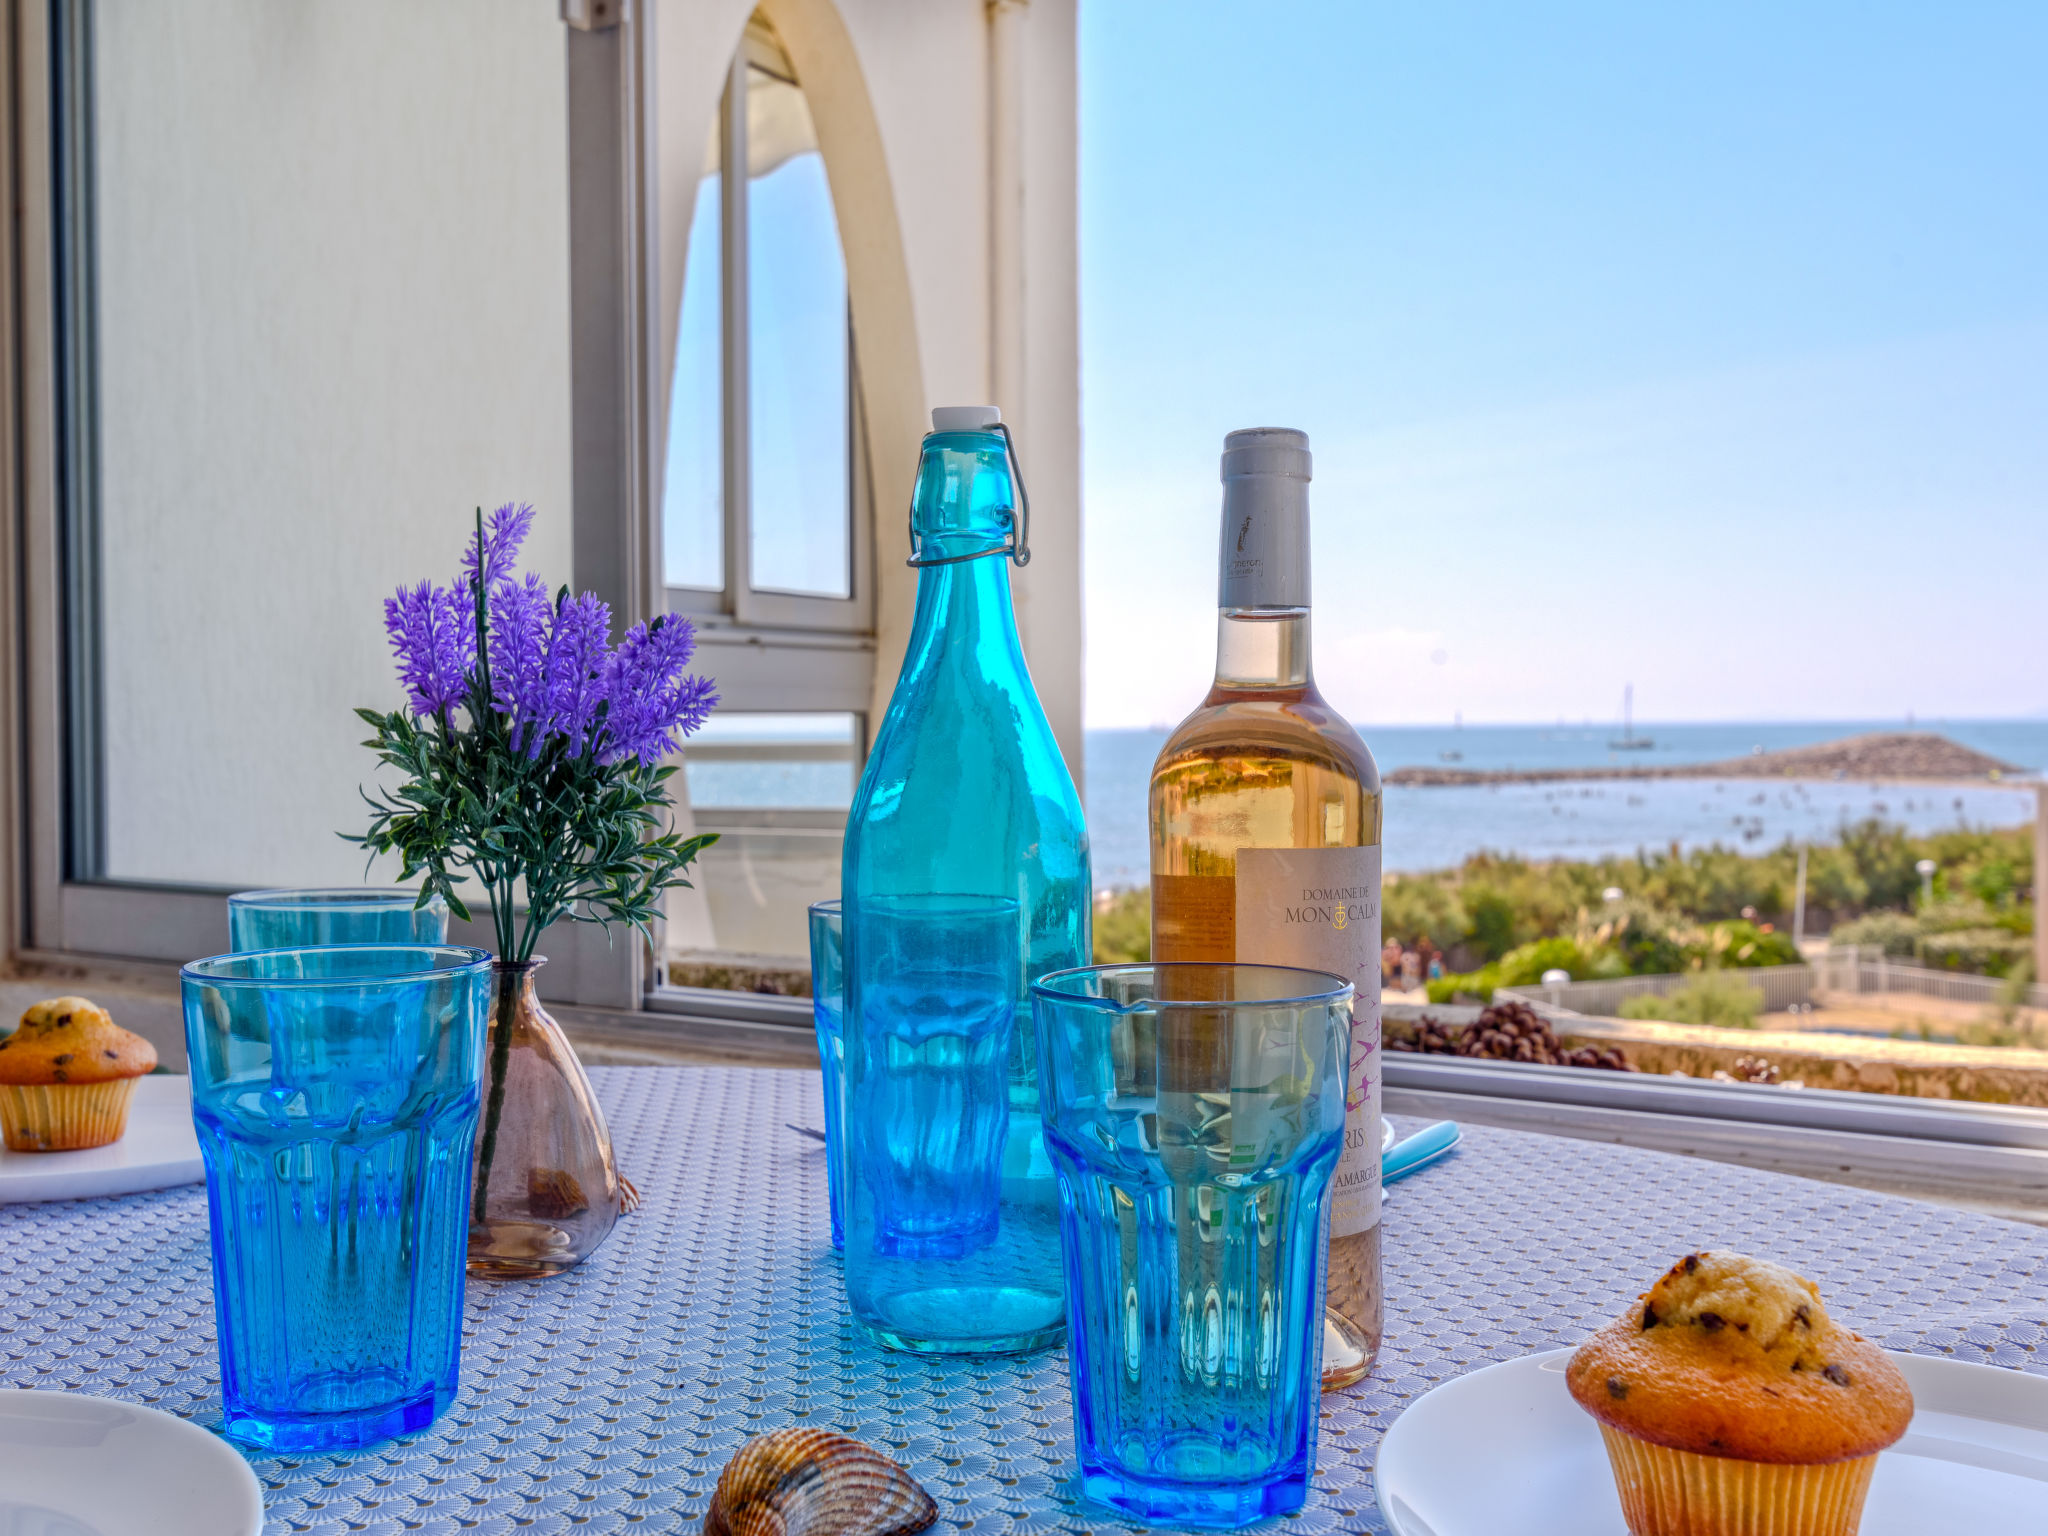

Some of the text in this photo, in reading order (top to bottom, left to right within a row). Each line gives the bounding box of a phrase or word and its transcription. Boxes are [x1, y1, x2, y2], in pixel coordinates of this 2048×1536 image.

[1303, 886, 1369, 901] DOMAINE DE
[1344, 1127, 1364, 1150] RIS
[1335, 1163, 1377, 1188] AMARGUE
